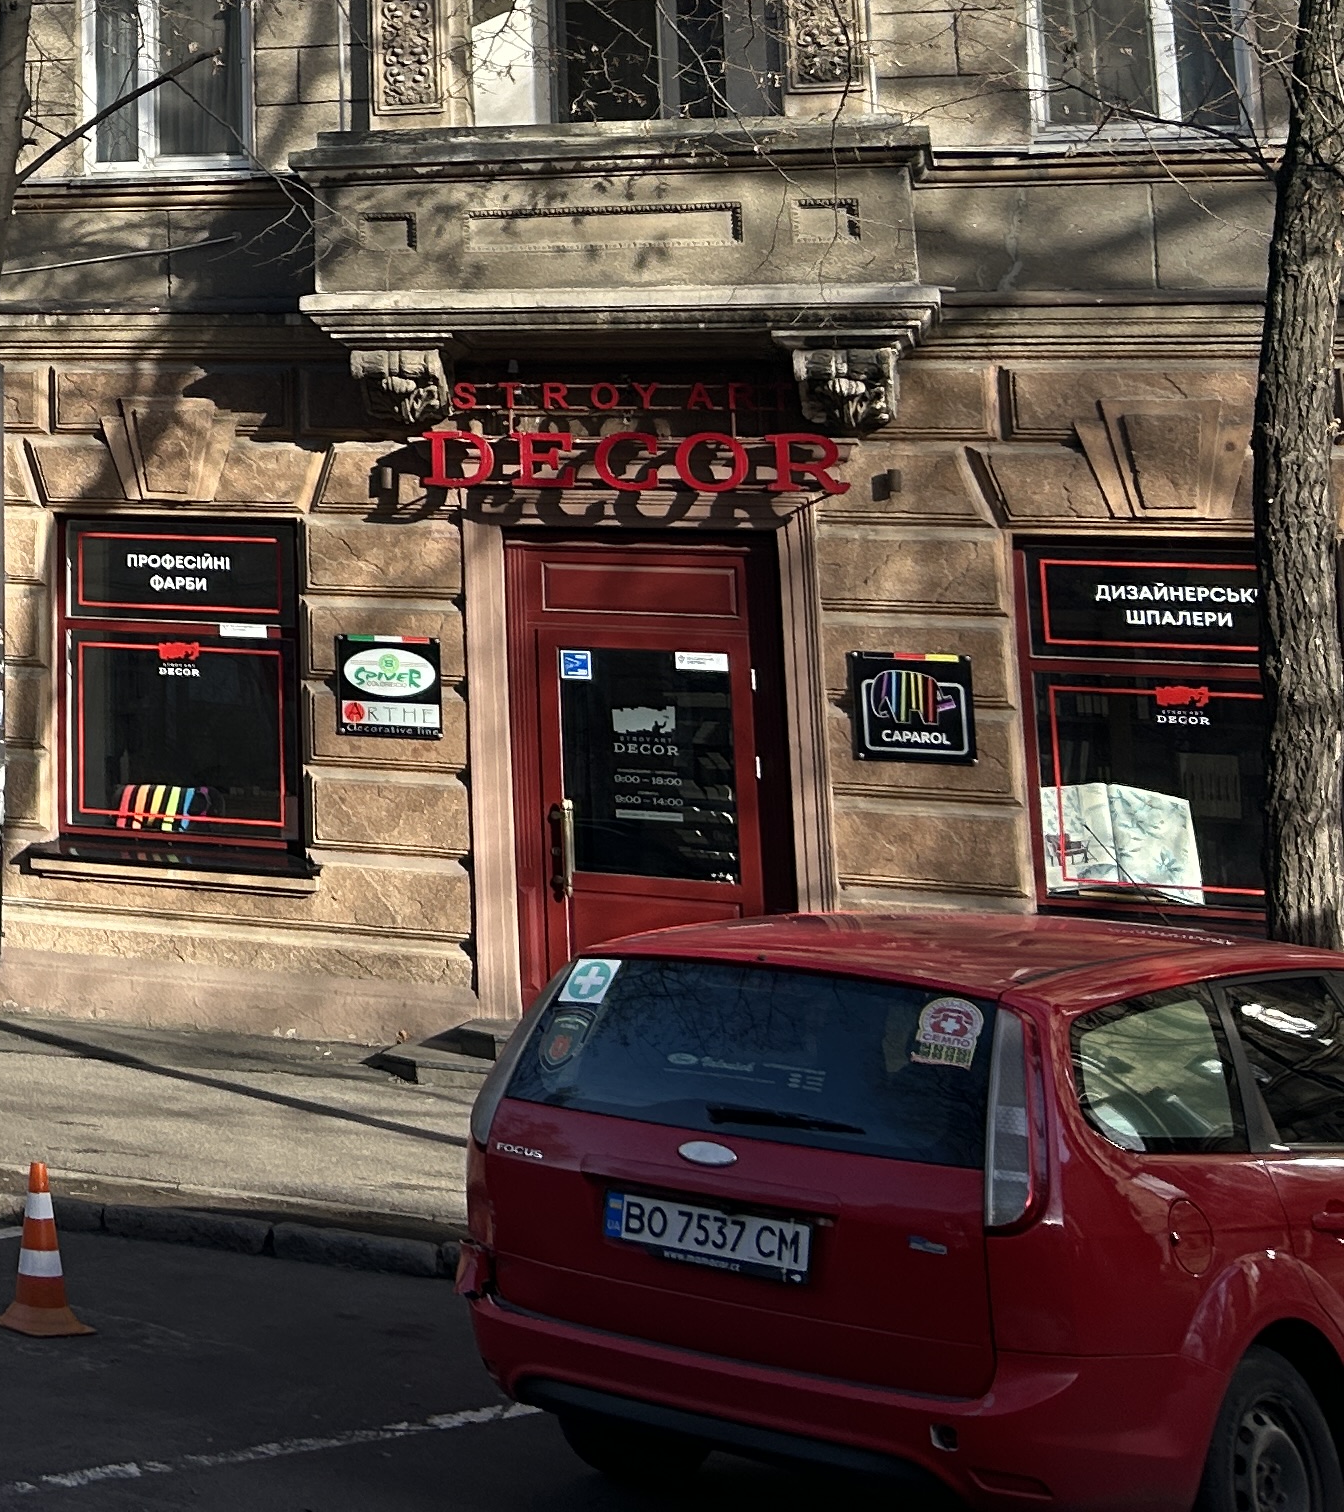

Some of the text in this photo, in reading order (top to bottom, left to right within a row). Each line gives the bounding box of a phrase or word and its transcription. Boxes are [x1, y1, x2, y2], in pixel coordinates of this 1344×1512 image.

[452, 381, 793, 411] STROY ART
[422, 431, 851, 495] DECOR
[126, 553, 231, 571] ПРОФЕСІЙНІ
[149, 574, 208, 591] ФАРБИ
[1125, 609, 1234, 628] ШПАЛЕРИ
[158, 666, 201, 677] DECOR
[346, 701, 437, 724] ARTHE
[1155, 715, 1211, 725] DECOR
[346, 723, 439, 736] decorative line
[881, 729, 951, 745] CAPAROL
[613, 742, 679, 756] DECOR
[652, 796, 684, 807] 14:00
[496, 1141, 544, 1159] FOCUS
[624, 1201, 801, 1264] BO 7537 CM
